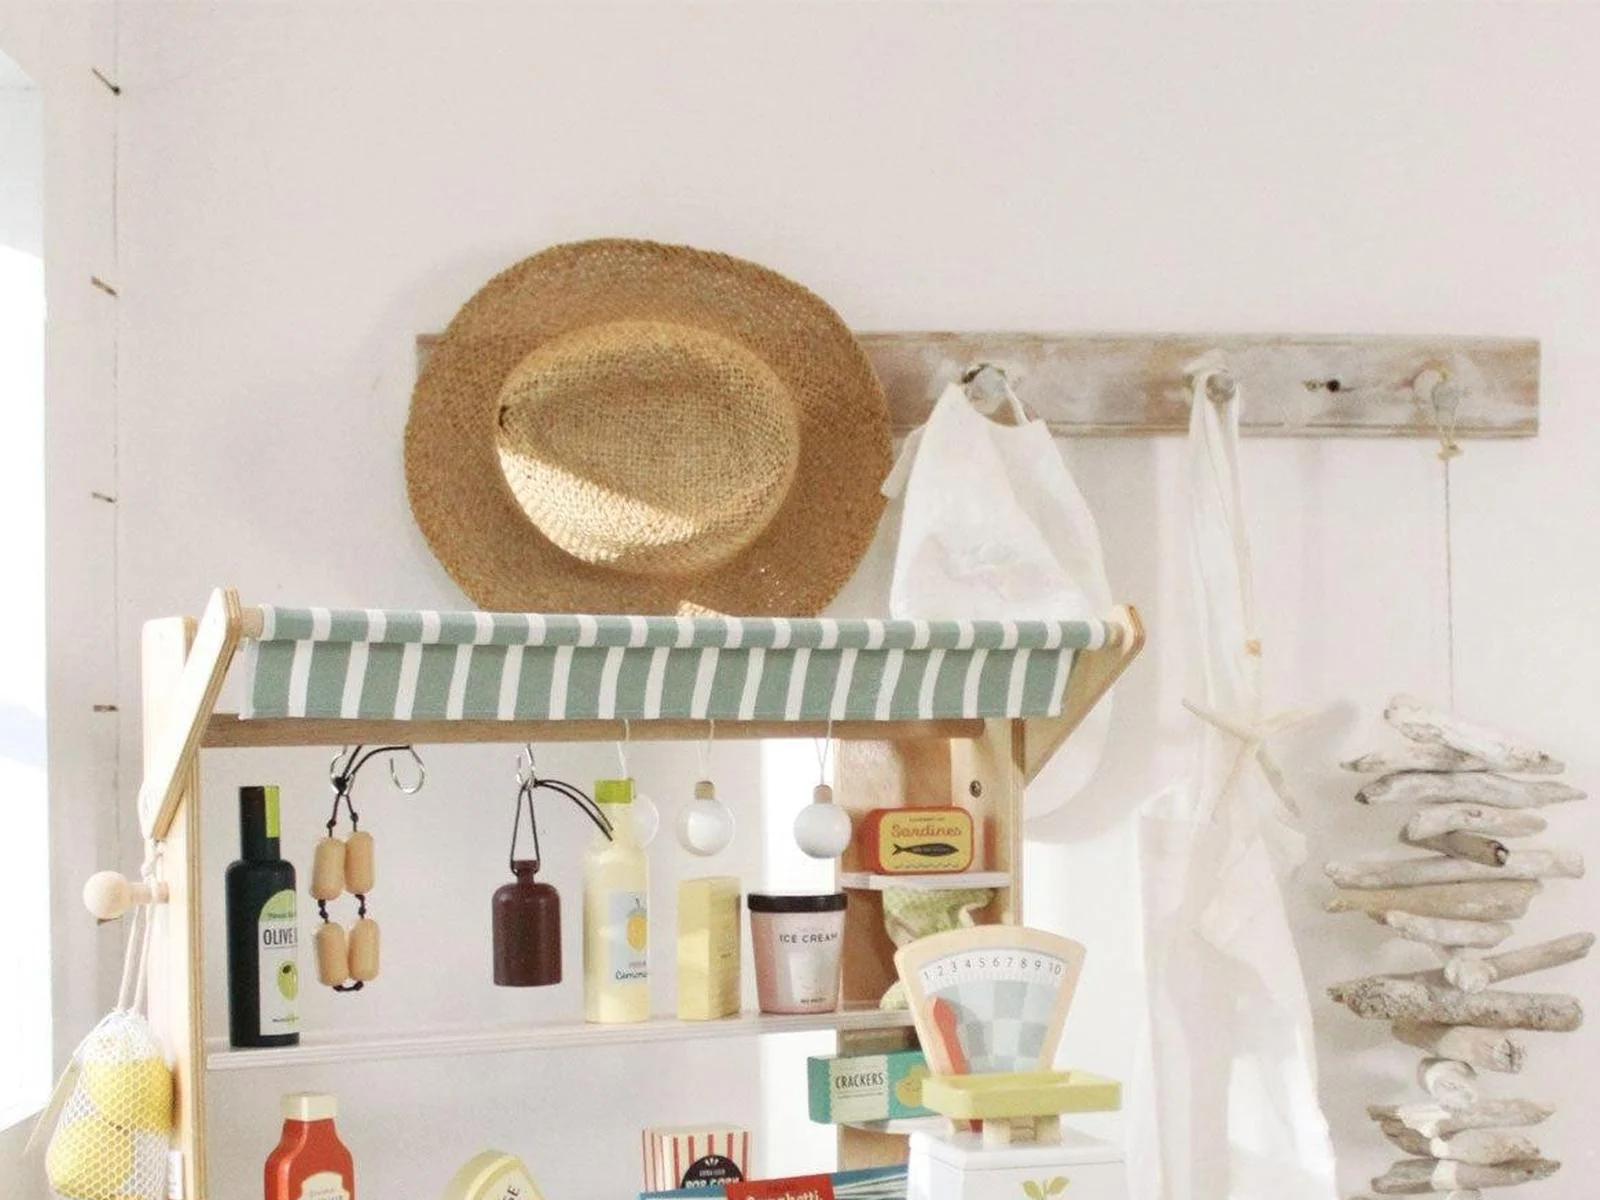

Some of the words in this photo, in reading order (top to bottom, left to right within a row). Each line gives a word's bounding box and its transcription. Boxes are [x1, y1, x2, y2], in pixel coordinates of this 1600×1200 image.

[891, 823, 962, 839] Sardines
[263, 927, 293, 946] OLIVE
[779, 934, 797, 944] ICE
[802, 932, 838, 944] CREAM
[937, 965, 944, 977] 2
[951, 961, 958, 973] 3
[965, 959, 972, 969] 4
[979, 957, 986, 968] 5
[993, 957, 1000, 968] 6
[1006, 957, 1014, 968] 7
[1020, 957, 1028, 969] 8
[1034, 960, 1041, 970] 9
[1048, 962, 1062, 976] 10
[835, 1072, 884, 1090] CRACKERS
